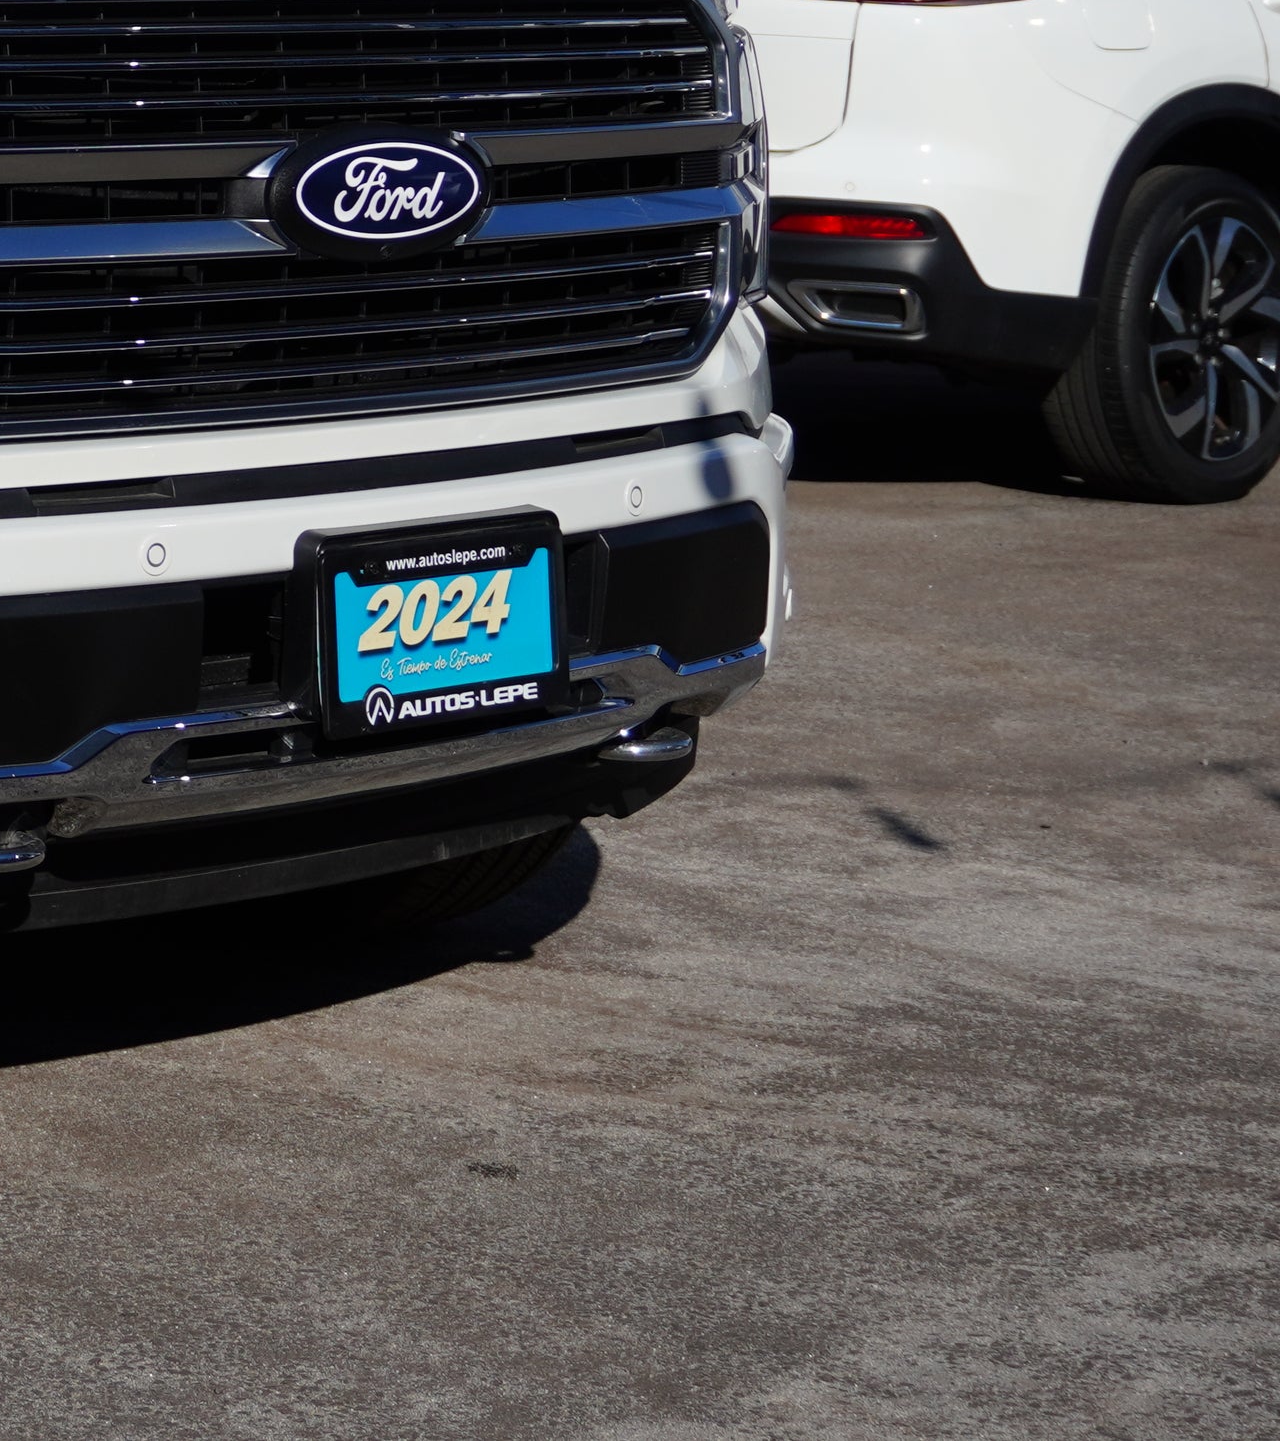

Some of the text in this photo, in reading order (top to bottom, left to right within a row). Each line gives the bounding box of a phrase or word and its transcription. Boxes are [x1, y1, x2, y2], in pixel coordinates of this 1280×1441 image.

[333, 155, 444, 223] Ford
[385, 545, 507, 571] www.autoslepe.com
[356, 568, 513, 653] 2024
[380, 648, 493, 681] Es Tiempo de Estrenar
